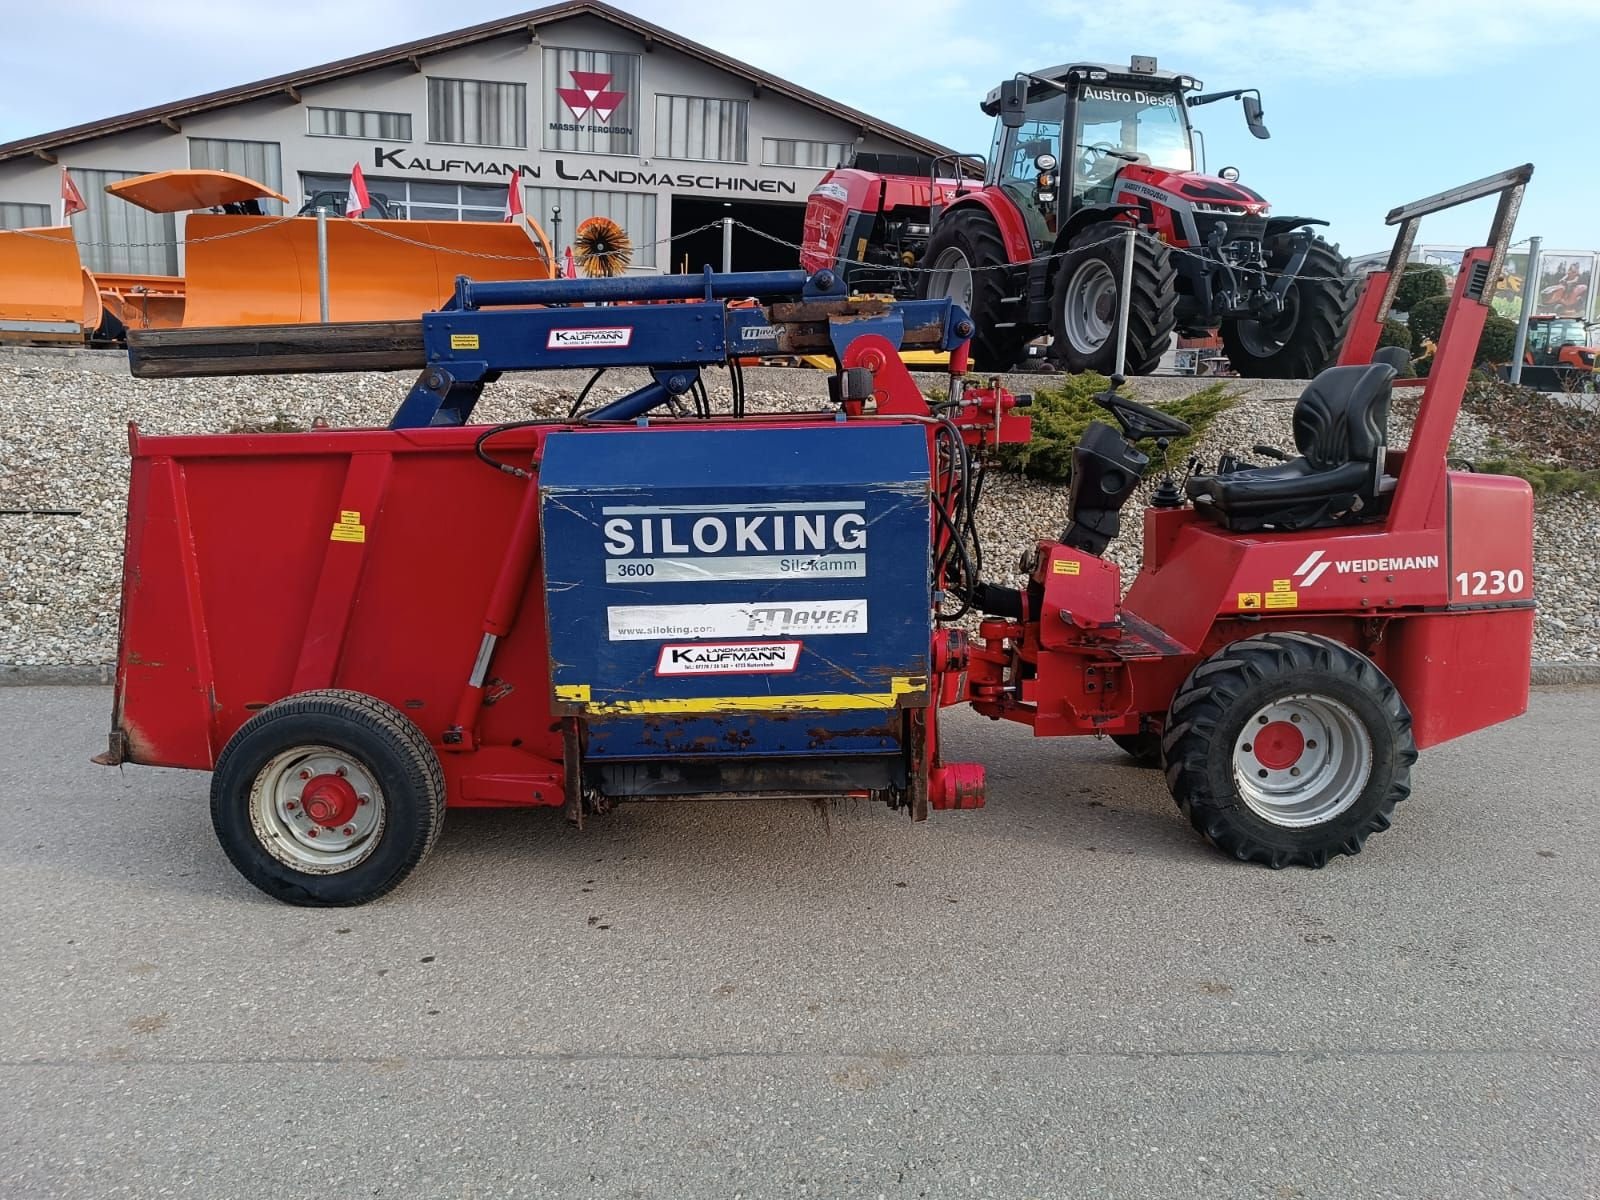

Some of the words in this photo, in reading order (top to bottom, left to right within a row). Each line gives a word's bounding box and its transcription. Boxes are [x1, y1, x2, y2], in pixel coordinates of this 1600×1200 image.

[1084, 86, 1131, 103] Austro
[1134, 91, 1177, 108] Diesel
[549, 122, 585, 132] MASSEY
[587, 125, 633, 135] FERGUSON
[374, 147, 541, 178] KAUFMANN
[555, 159, 796, 194] LANDMASCHINEN
[1141, 186, 1169, 203] FERGUSON
[555, 332, 623, 341] KAUFMANN
[603, 512, 868, 556] SILOKING
[618, 563, 655, 577] 3600
[780, 558, 857, 572] Silokamm
[1335, 555, 1439, 574] WEIDEMANN
[1455, 569, 1524, 597] 1230
[746, 608, 859, 631] MAYER
[672, 649, 786, 663] KAUFMANN
